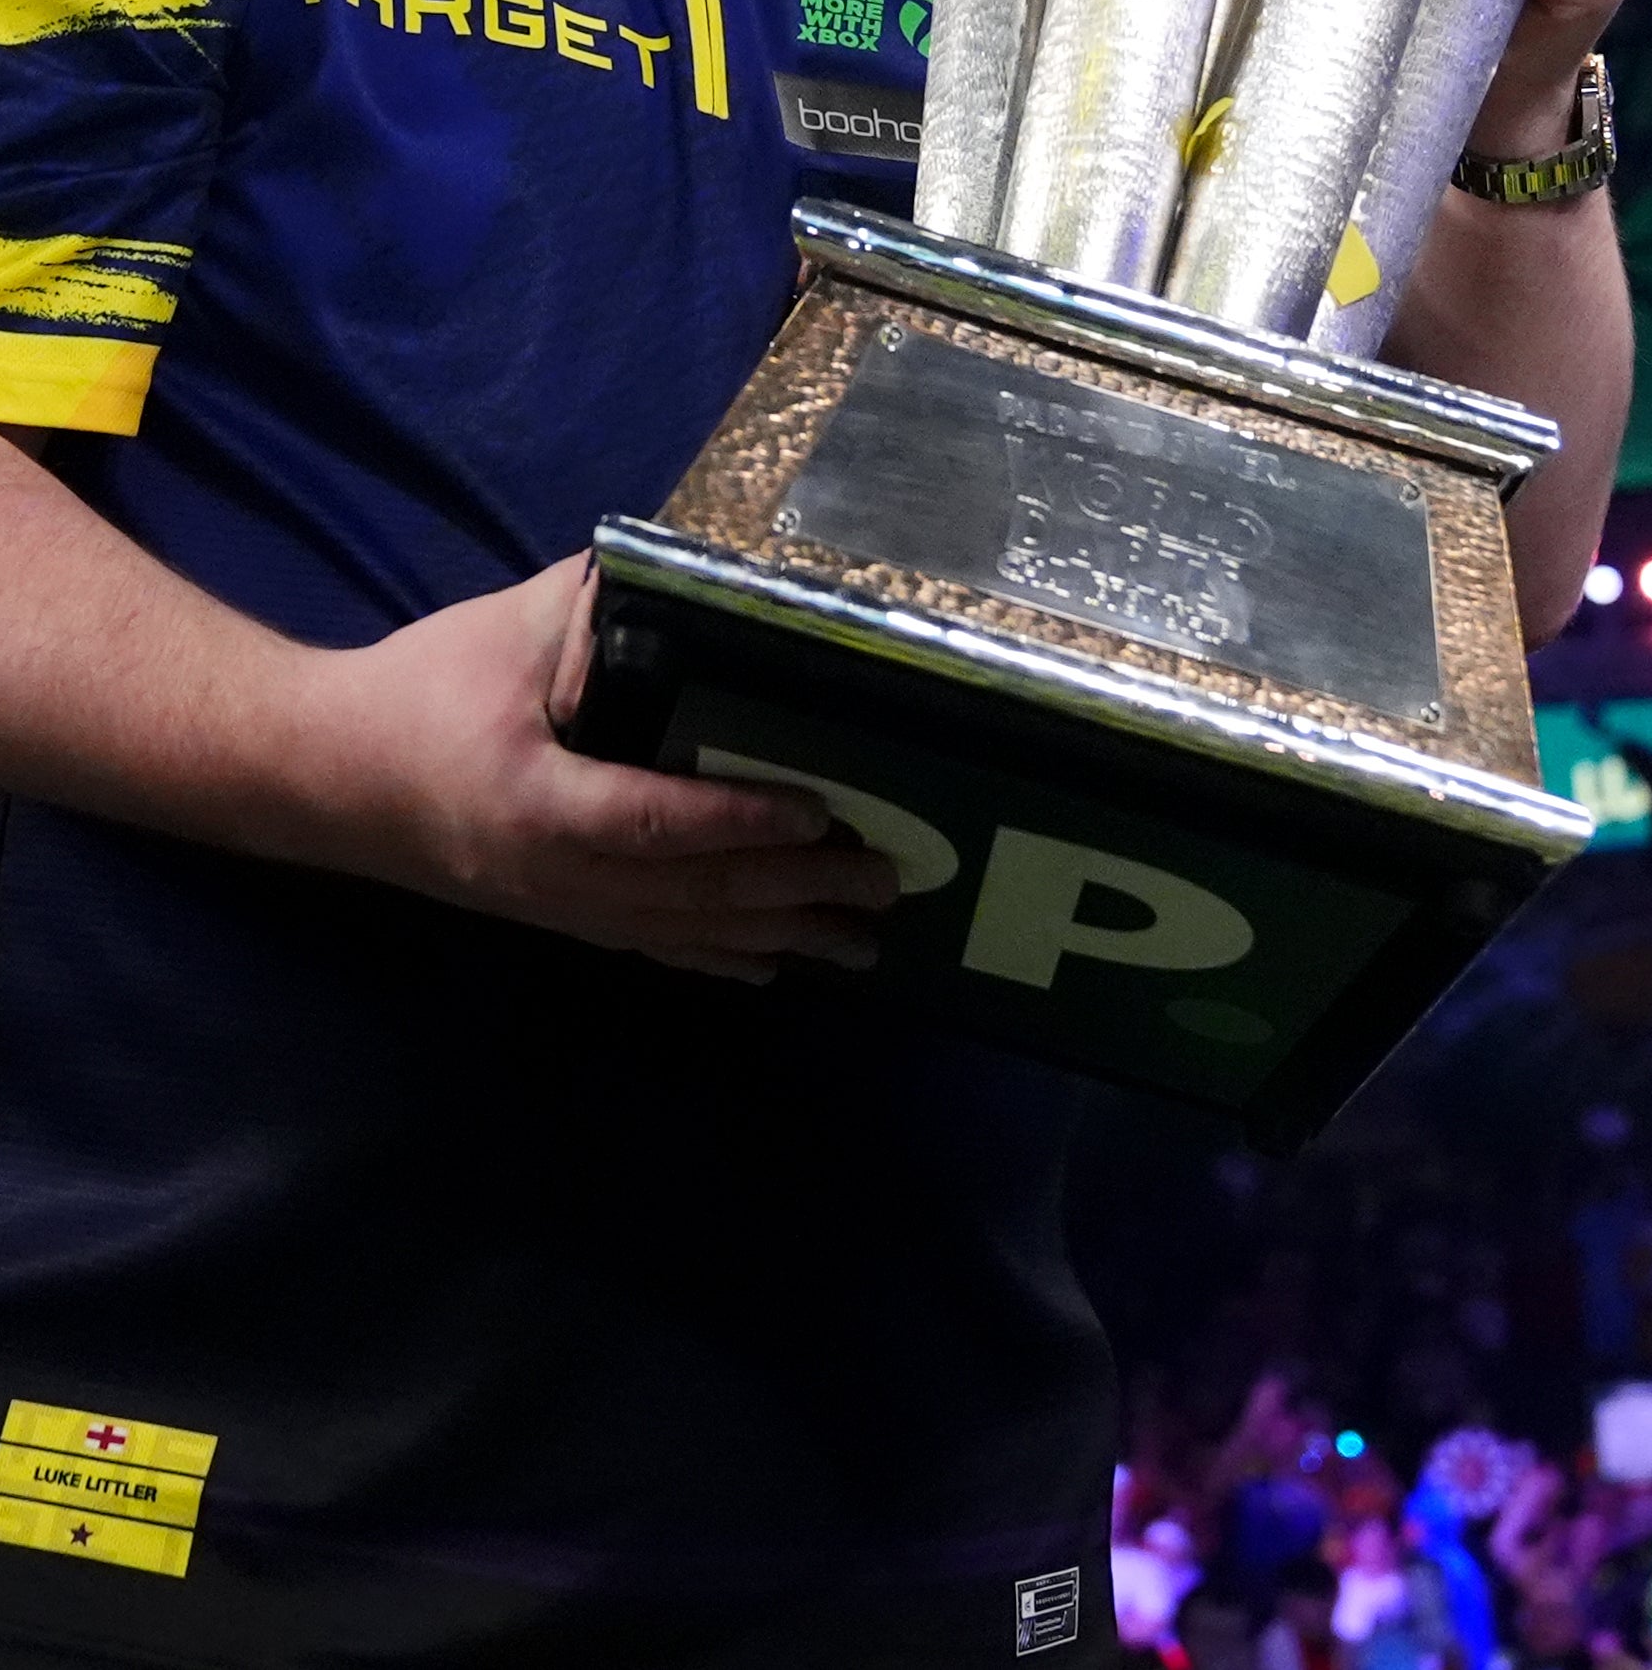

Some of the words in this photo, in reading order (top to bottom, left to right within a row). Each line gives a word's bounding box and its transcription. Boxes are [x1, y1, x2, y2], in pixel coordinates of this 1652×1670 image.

[797, 23, 880, 53] XBOX
[804, 8, 882, 37] WITH
[797, 96, 924, 144] booho
[33, 1465, 82, 1488] LUKE
[85, 1476, 158, 1502] LITTLER
